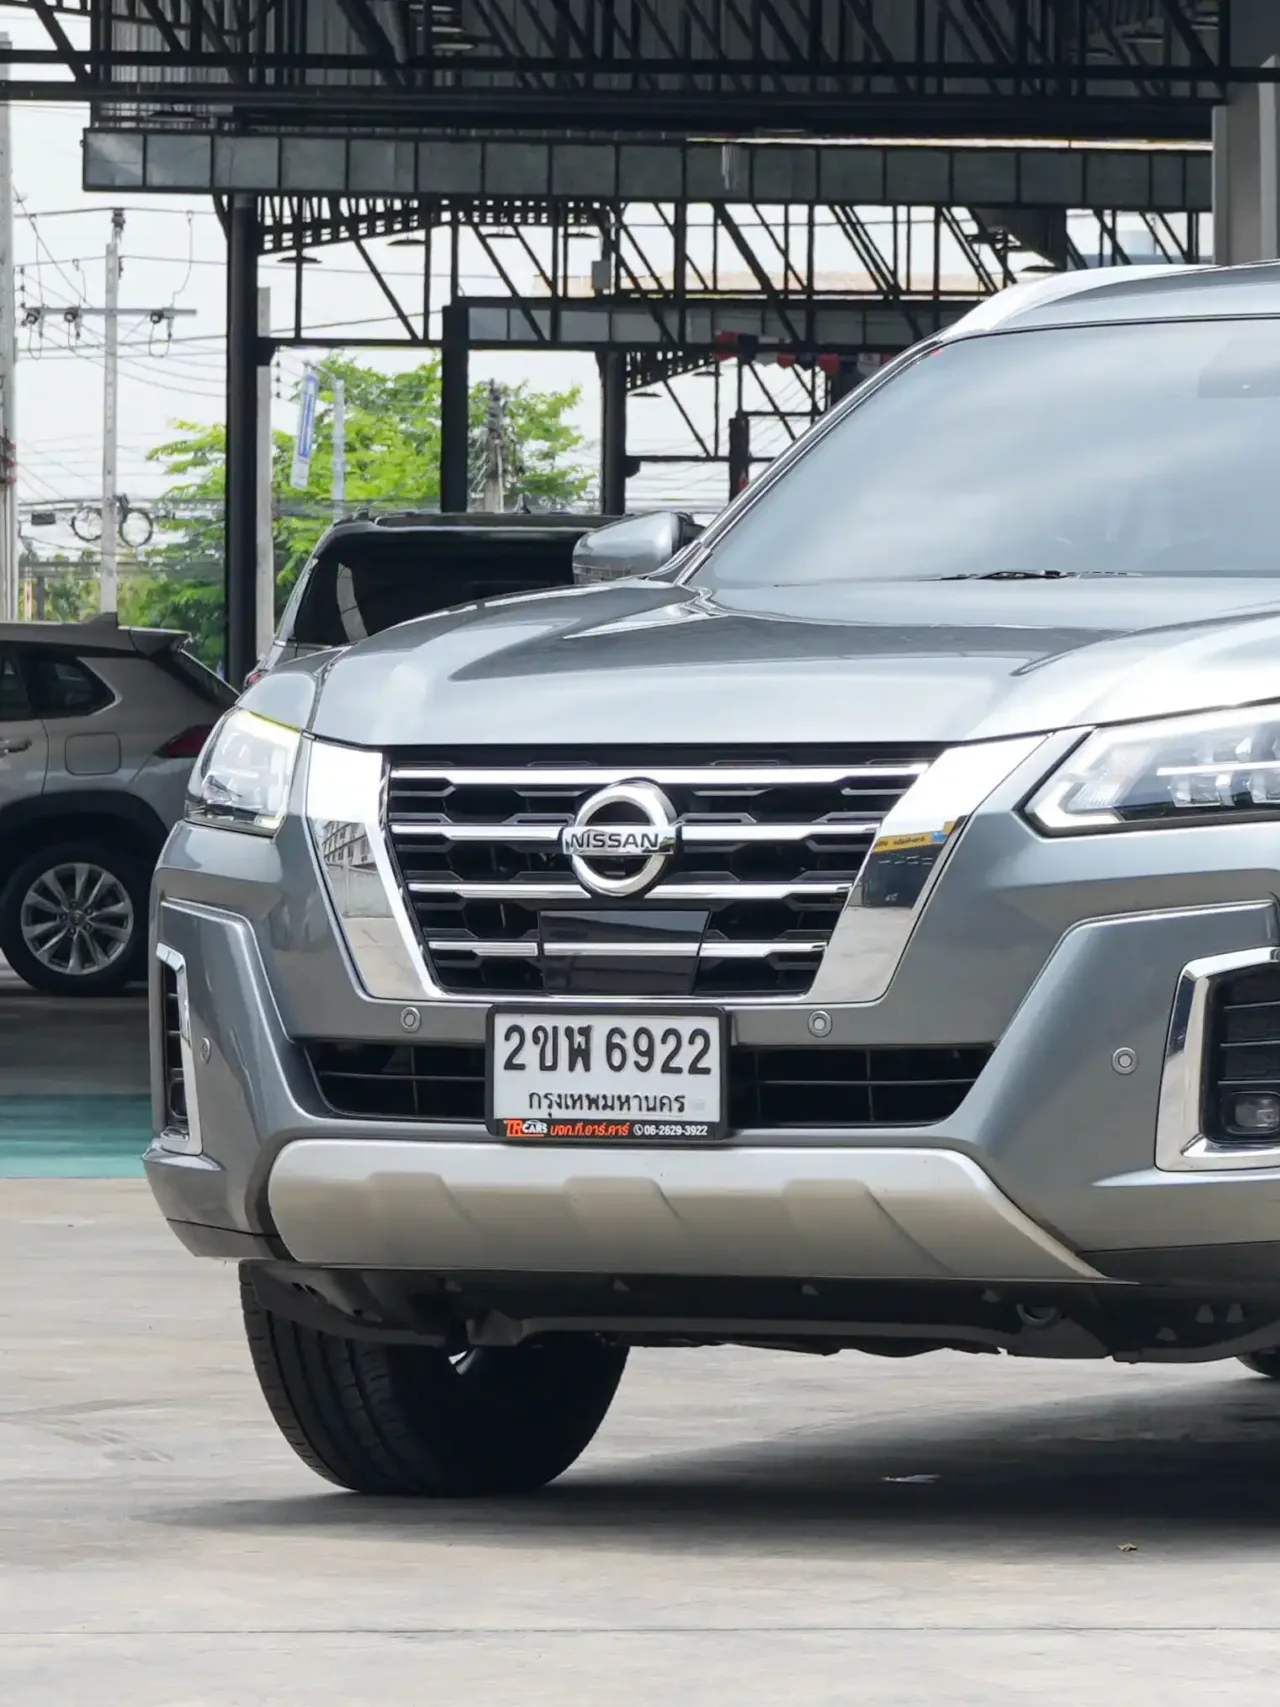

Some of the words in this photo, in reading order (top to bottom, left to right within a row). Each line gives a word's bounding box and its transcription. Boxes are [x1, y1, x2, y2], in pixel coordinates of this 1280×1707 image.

[570, 833, 659, 849] NISSAN
[606, 1027, 712, 1075] 6922
[528, 1091, 686, 1118] กรุงเทพมหานคร
[644, 1124, 708, 1136] 06-2629-3922
